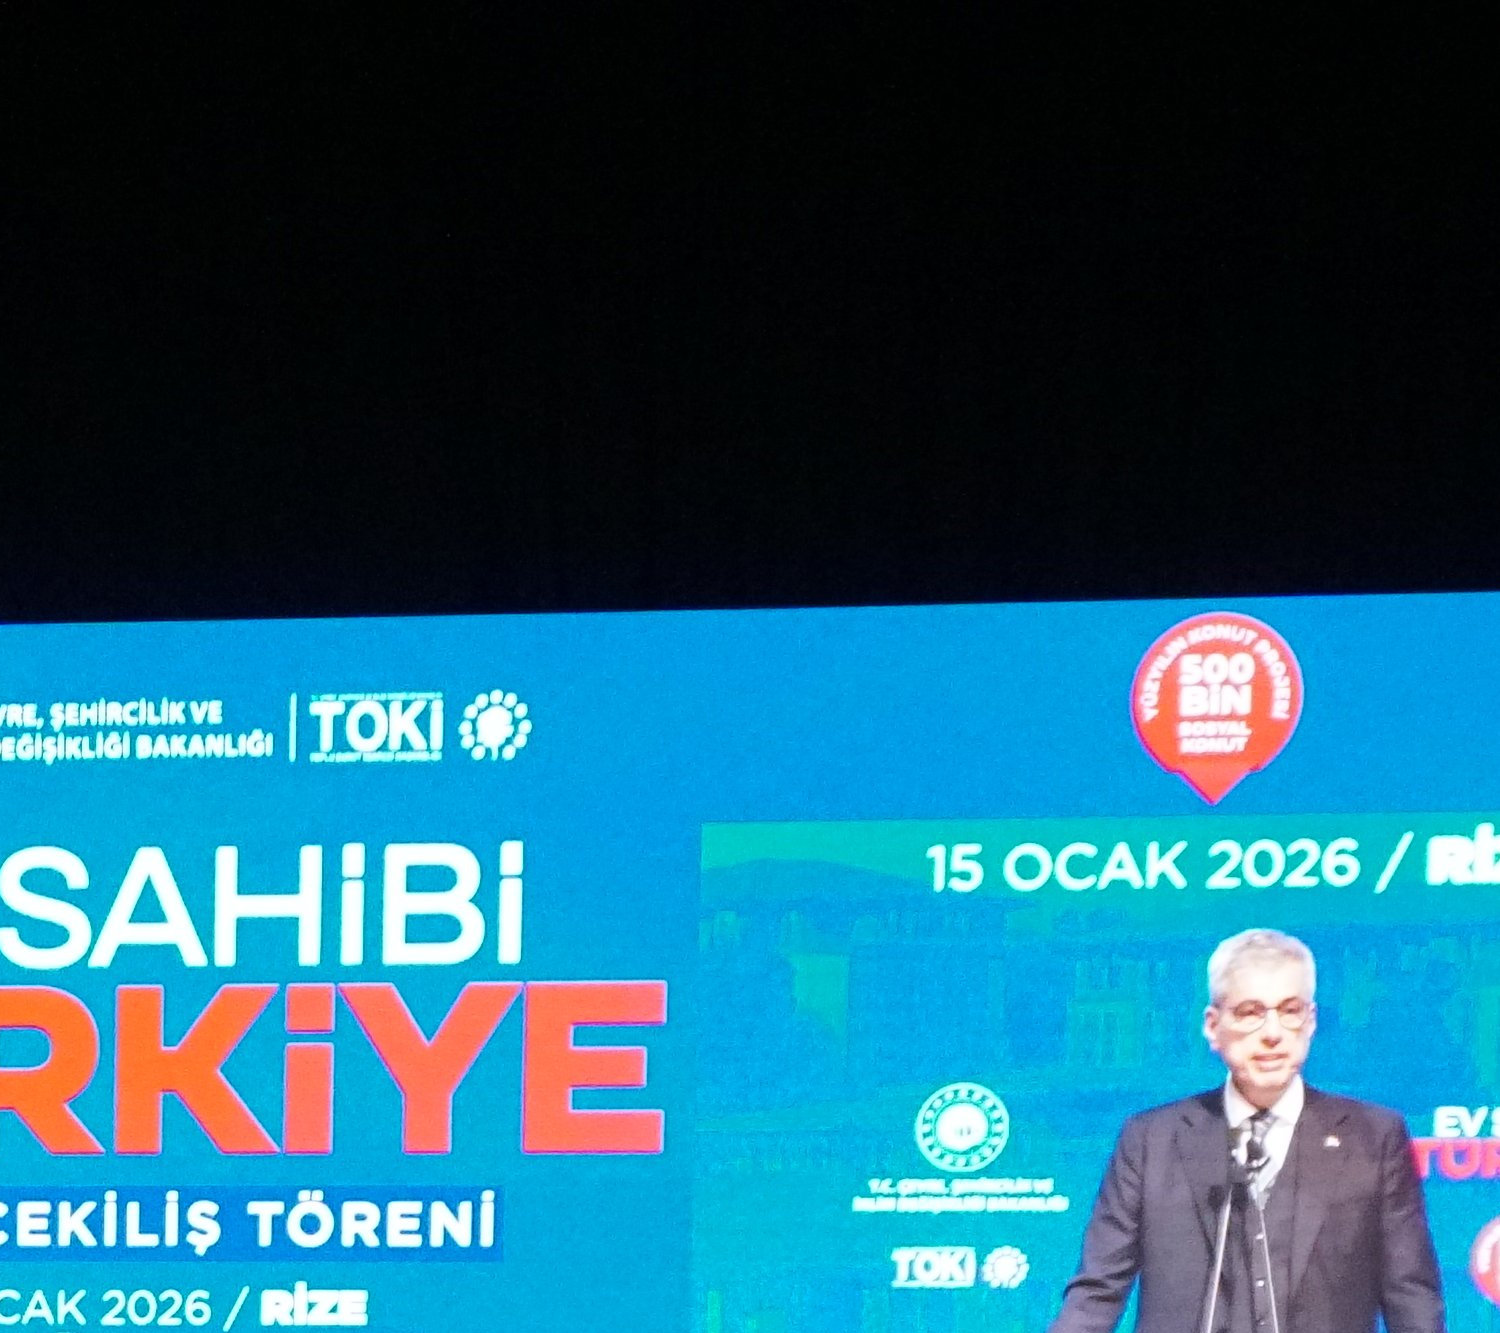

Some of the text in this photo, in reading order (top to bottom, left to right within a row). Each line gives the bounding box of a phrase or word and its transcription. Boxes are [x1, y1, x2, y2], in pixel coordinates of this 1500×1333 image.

[1179, 652, 1256, 685] 500
[190, 701, 223, 725] VE
[927, 843, 984, 892] 15
[1003, 840, 1187, 892] OCAK
[1205, 836, 1360, 890] 2026
[1374, 831, 1414, 893] /
[1434, 1106, 1488, 1137] EV
[246, 1188, 496, 1248] TÖRENİ
[100, 1287, 212, 1326] 2026
[222, 1285, 250, 1332] /
